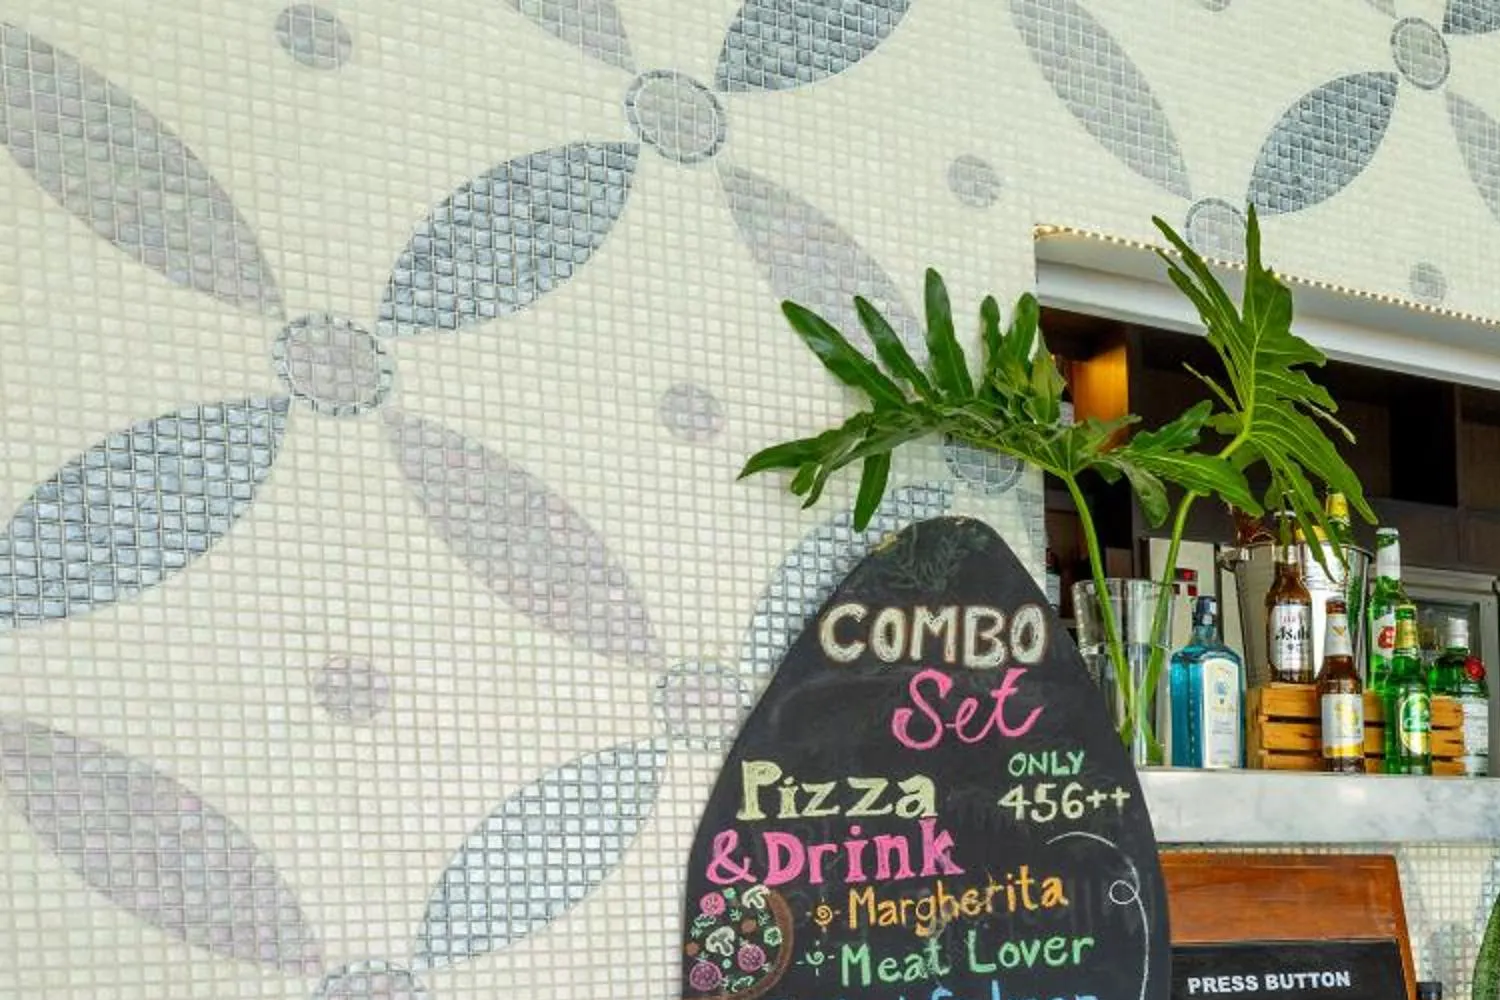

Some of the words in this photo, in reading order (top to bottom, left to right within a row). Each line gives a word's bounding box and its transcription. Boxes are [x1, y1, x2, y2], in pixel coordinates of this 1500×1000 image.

[819, 602, 1047, 669] COMBO
[891, 667, 1045, 750] Set
[736, 760, 939, 820] Pizza
[1008, 750, 1086, 777] ONLY
[997, 782, 1132, 824] 456++
[847, 864, 1070, 937] Margherita
[840, 936, 952, 988] Meat
[967, 928, 1096, 972] Lover
[1187, 974, 1259, 994] PRESS
[1265, 971, 1351, 991] BUTTON
